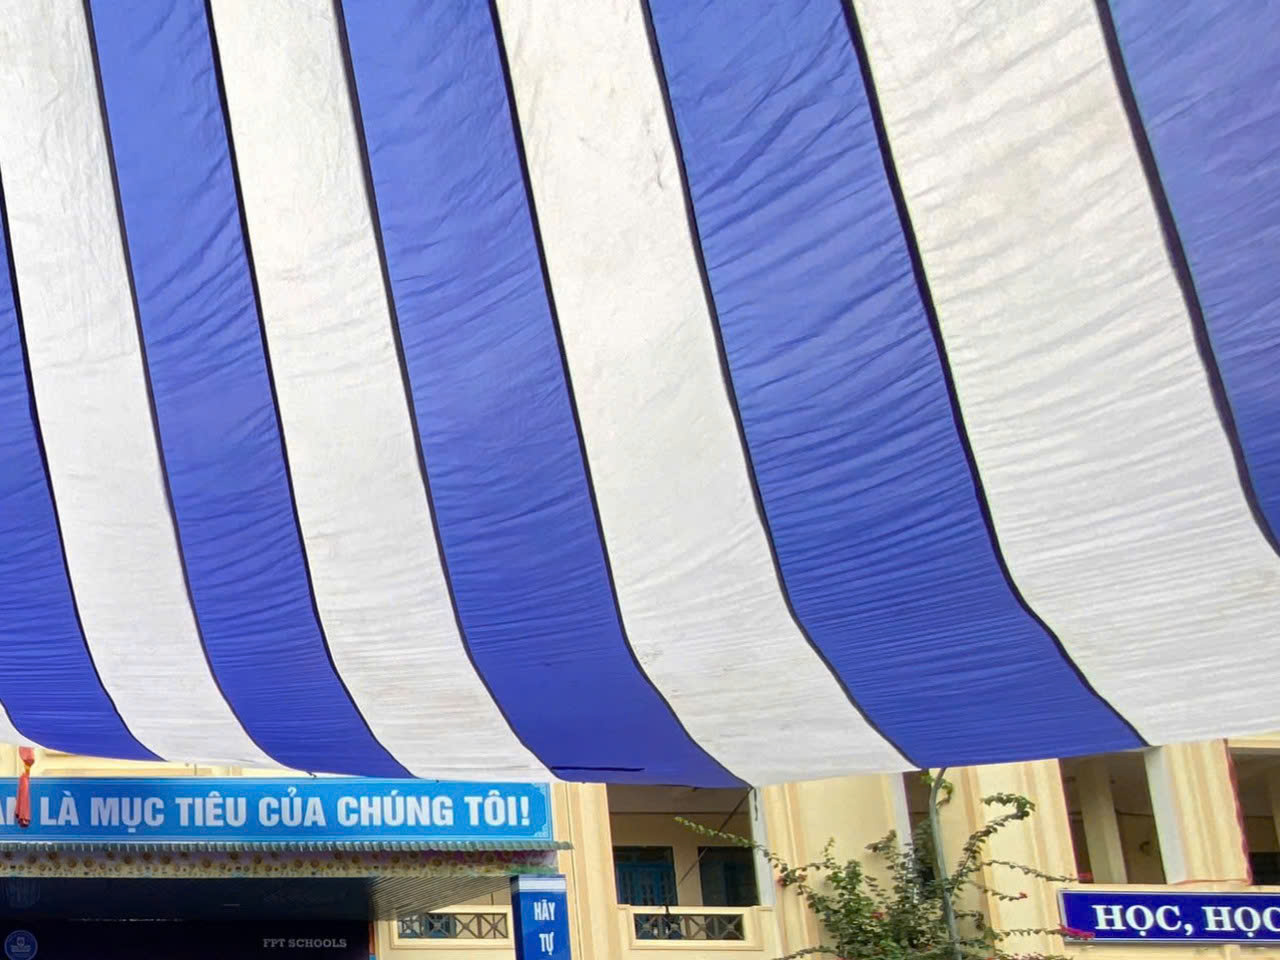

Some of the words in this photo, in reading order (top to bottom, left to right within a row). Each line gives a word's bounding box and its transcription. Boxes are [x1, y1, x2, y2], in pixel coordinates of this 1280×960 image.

[40, 791, 79, 826] LÀ
[91, 797, 164, 833] MỤC
[176, 791, 247, 827] TIÊU
[258, 787, 326, 827] CỦA
[337, 790, 453, 827] CHÚNG
[464, 790, 529, 827] TÔI!
[534, 900, 555, 920] HÃY
[1092, 905, 1193, 936] HỌC,
[263, 938, 285, 948] FPT
[288, 938, 347, 948] SCHOOLS
[539, 932, 554, 955] TỰ
